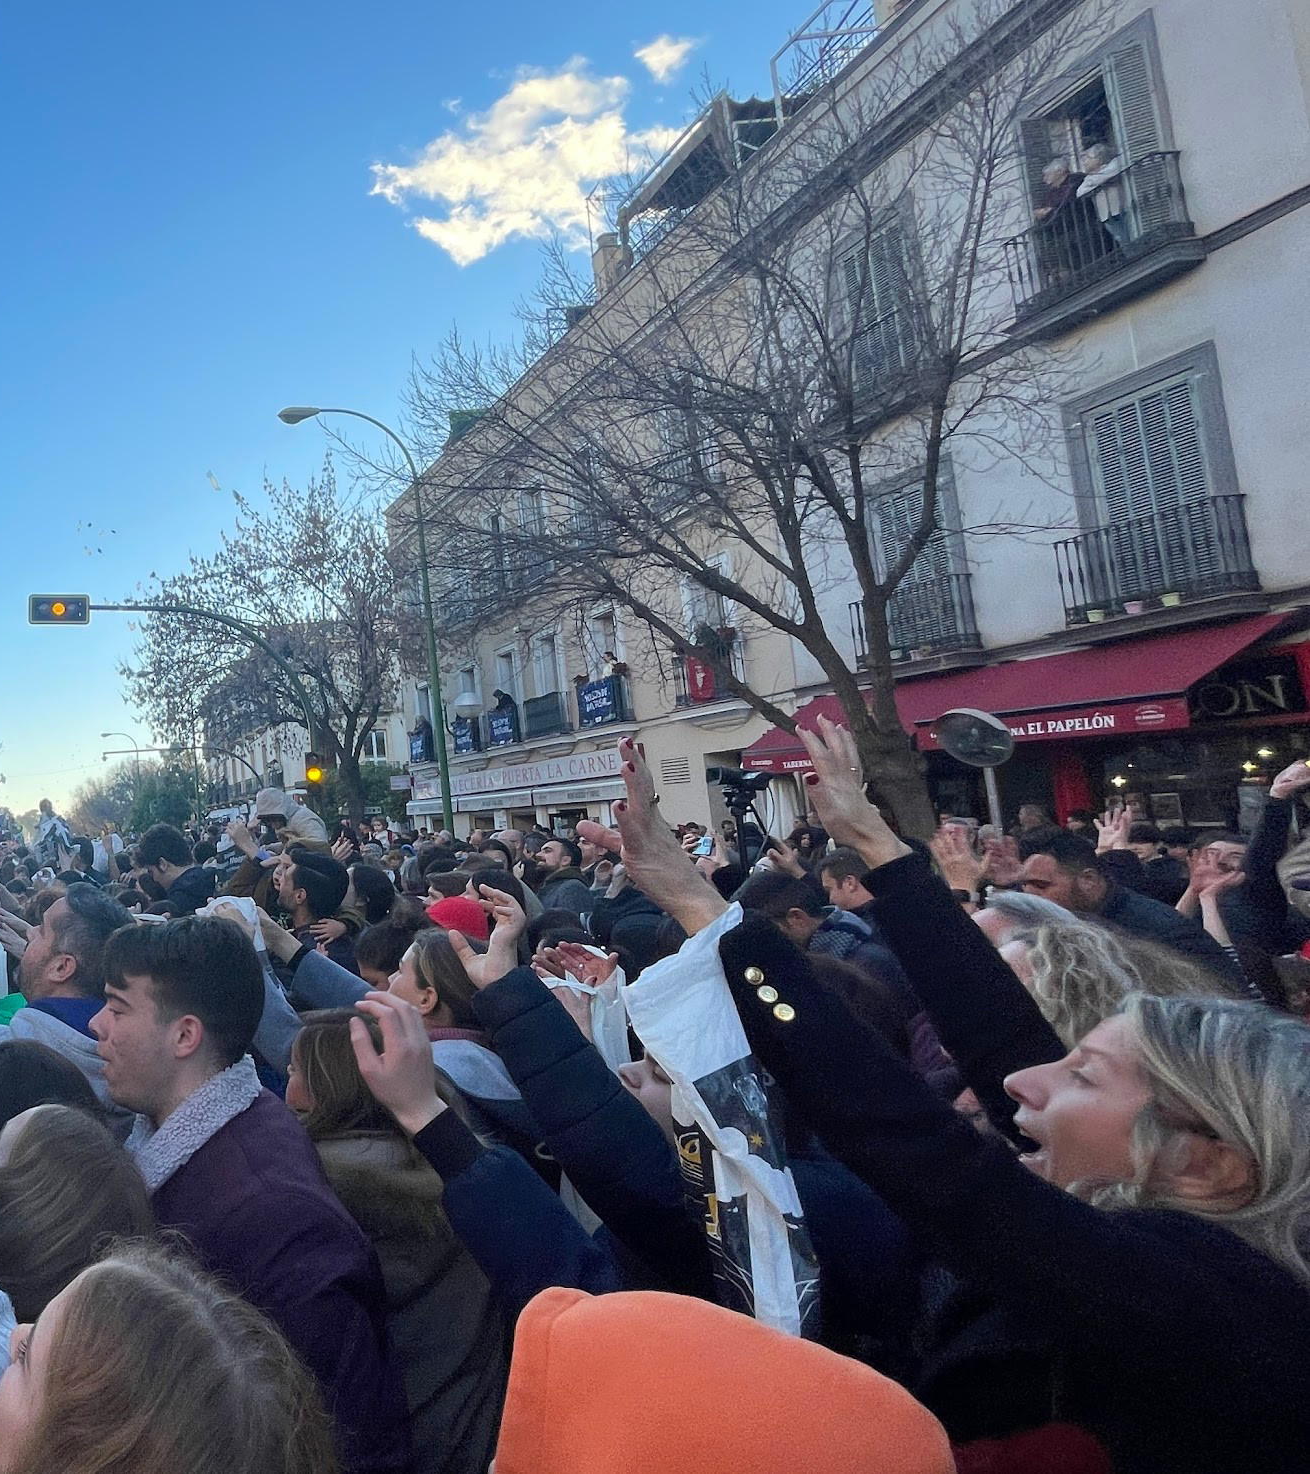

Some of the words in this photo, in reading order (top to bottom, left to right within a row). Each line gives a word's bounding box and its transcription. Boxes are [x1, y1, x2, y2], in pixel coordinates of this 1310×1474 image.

[1027, 721, 1045, 735] EL
[1047, 712, 1115, 733] PAPELÓN
[501, 766, 542, 785] PUERTA
[547, 763, 563, 779] LA
[569, 753, 617, 776] CARNE
